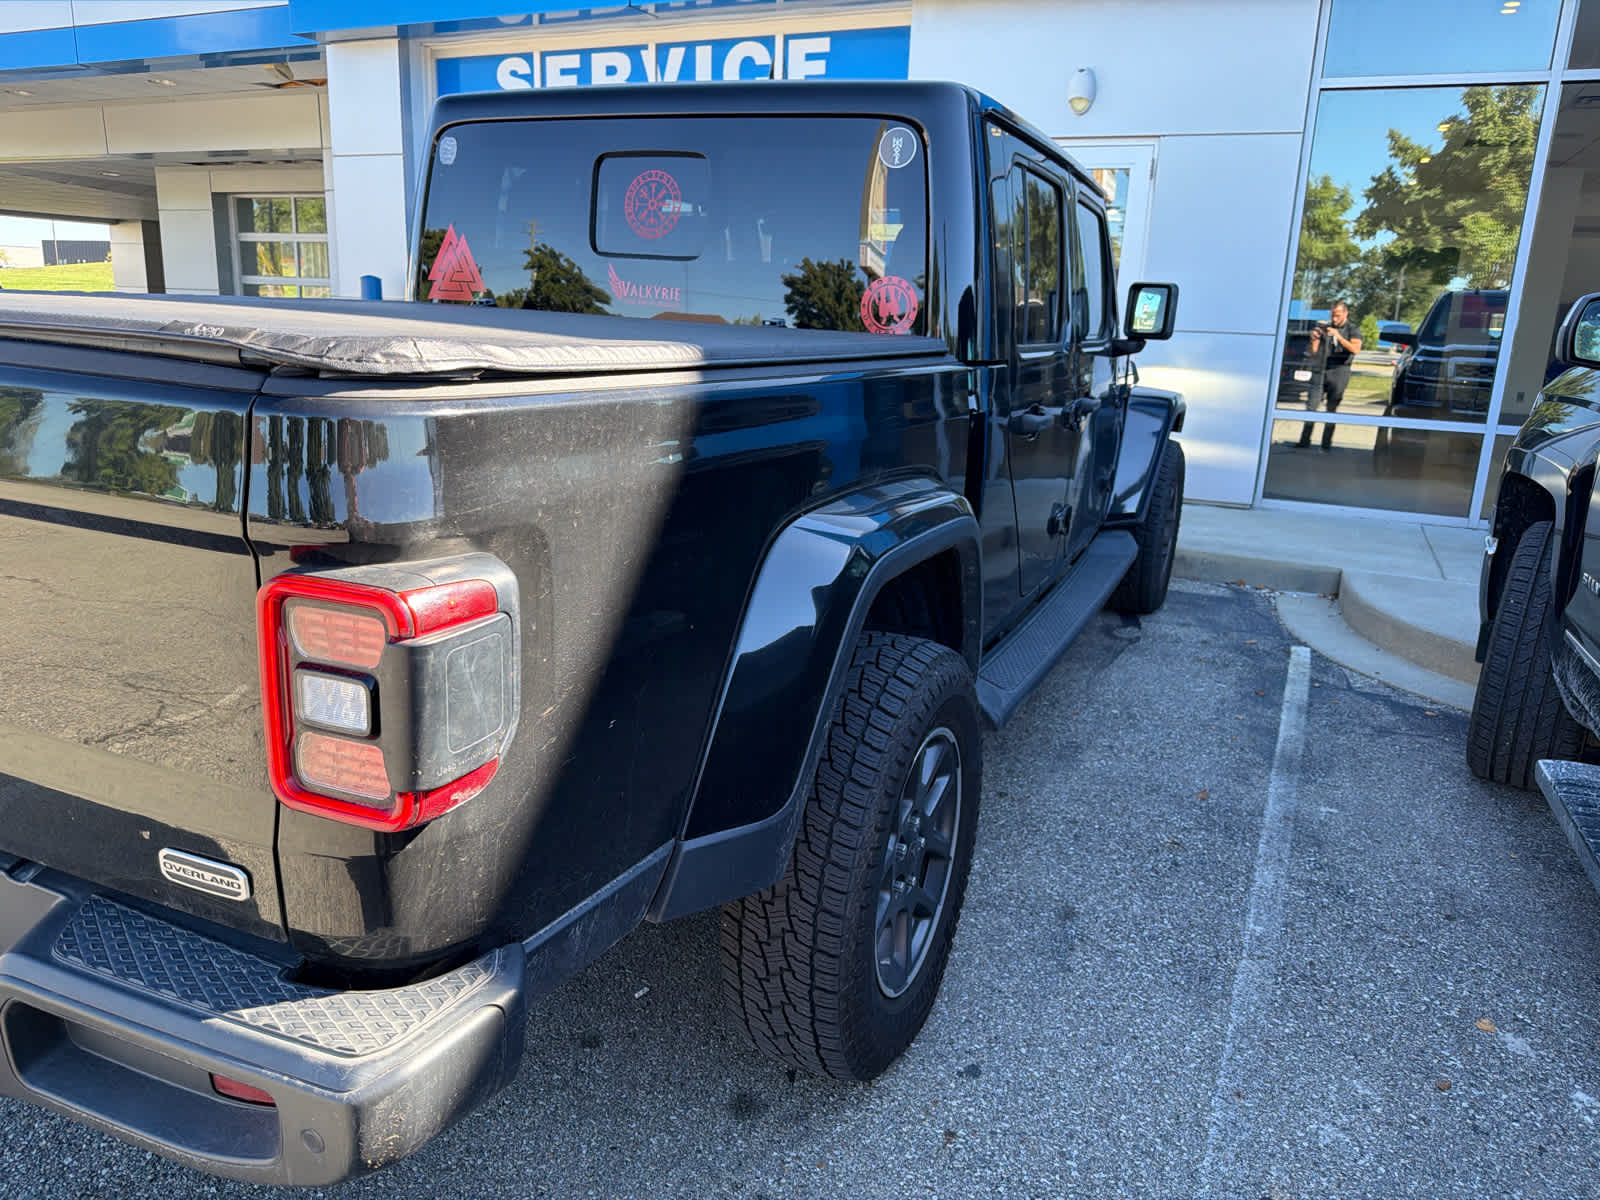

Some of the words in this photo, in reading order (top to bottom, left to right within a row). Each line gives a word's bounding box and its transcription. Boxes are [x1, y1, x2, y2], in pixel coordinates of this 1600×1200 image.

[495, 36, 832, 90] SERVICE
[622, 280, 680, 301] VALKYRIE
[163, 861, 241, 890] OVERLAND
